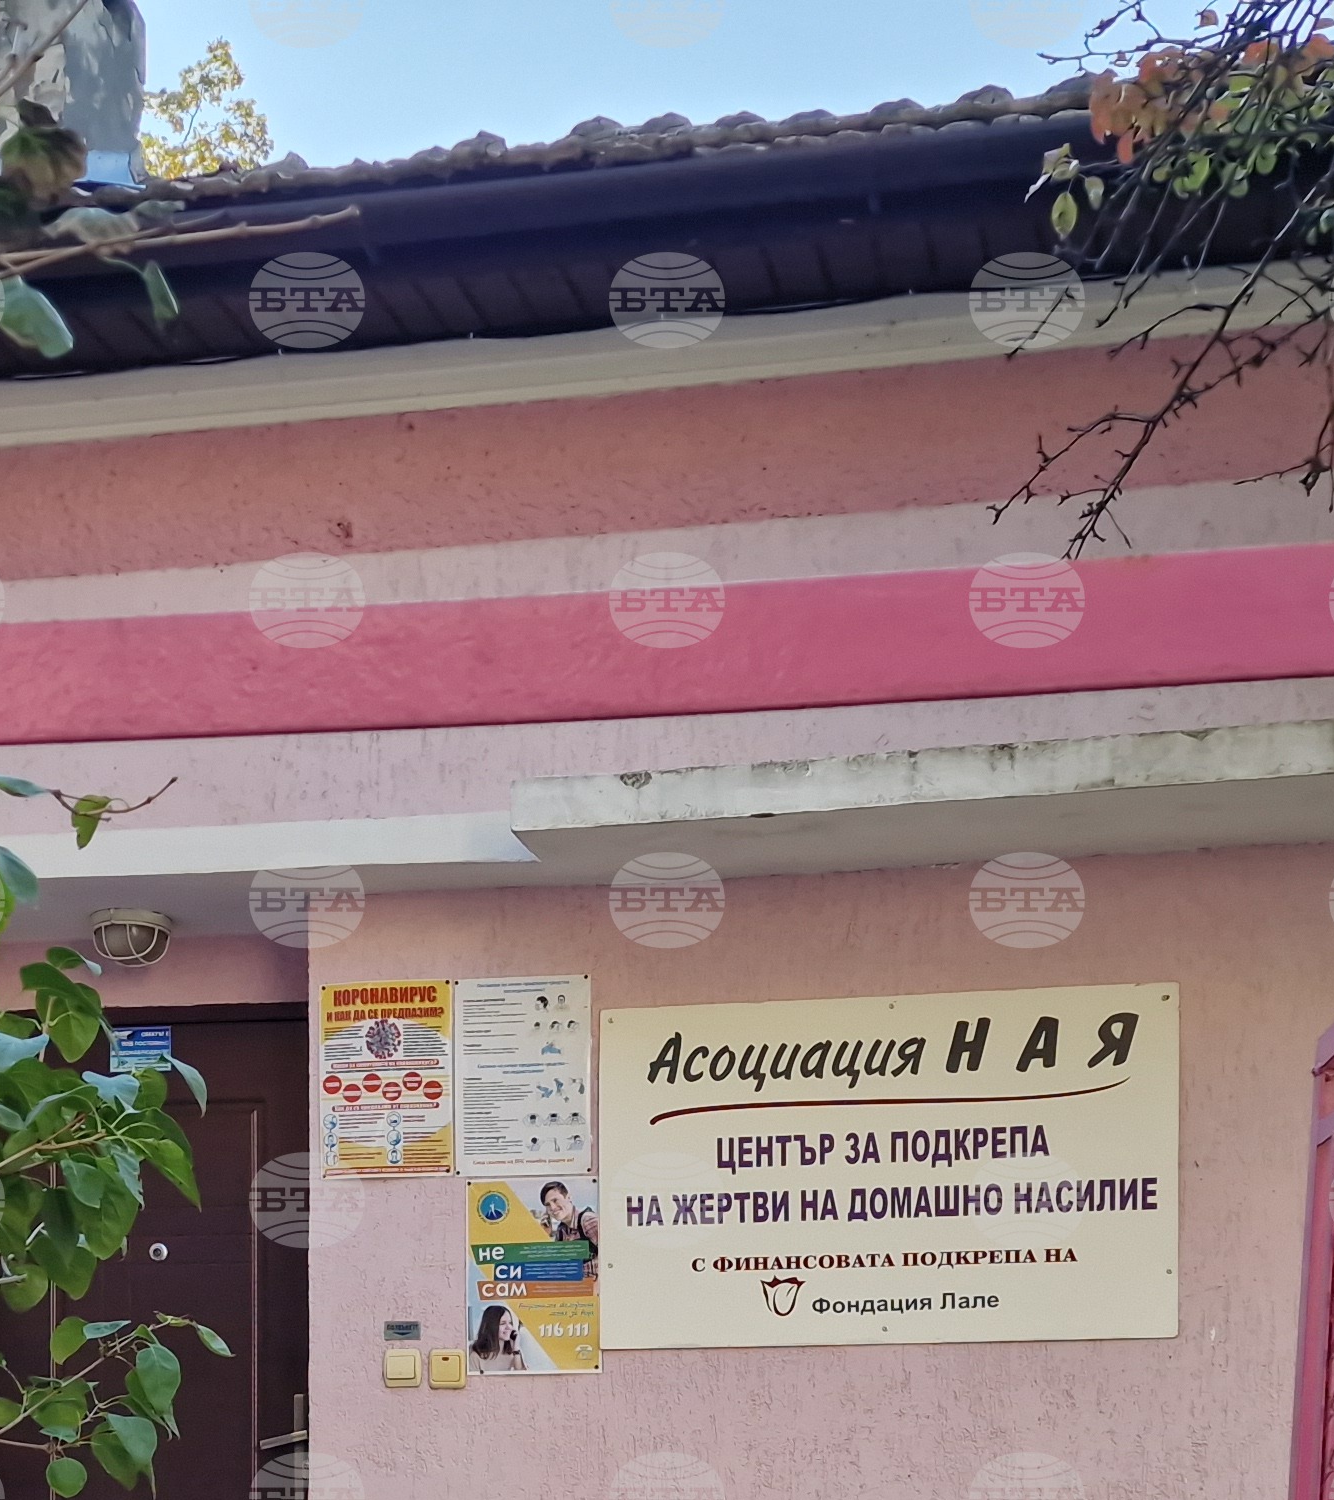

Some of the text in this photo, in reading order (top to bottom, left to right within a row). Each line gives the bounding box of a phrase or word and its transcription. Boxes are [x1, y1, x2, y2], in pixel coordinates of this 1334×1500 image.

[333, 986, 438, 1007] КОРОНАВИРУС
[353, 1009, 366, 1022] ДА
[367, 1008, 379, 1020] СЕ
[647, 1031, 927, 1091] Асоциация
[716, 1125, 1050, 1175] ЦЕНТЪР ЗА ПОДКРЕПА
[626, 1176, 1158, 1227] НА ЖЕРТВИ НА ДОМАШНО НАСИЛИЕ
[478, 1246, 505, 1262] не
[691, 1248, 1078, 1273] С ФИНАНСОВАТА ПОДКРЕПА НА
[495, 1264, 522, 1280] си
[481, 1282, 527, 1297] сам
[811, 1292, 1000, 1315] Фондация Лале
[539, 1322, 589, 1337] 116 111
